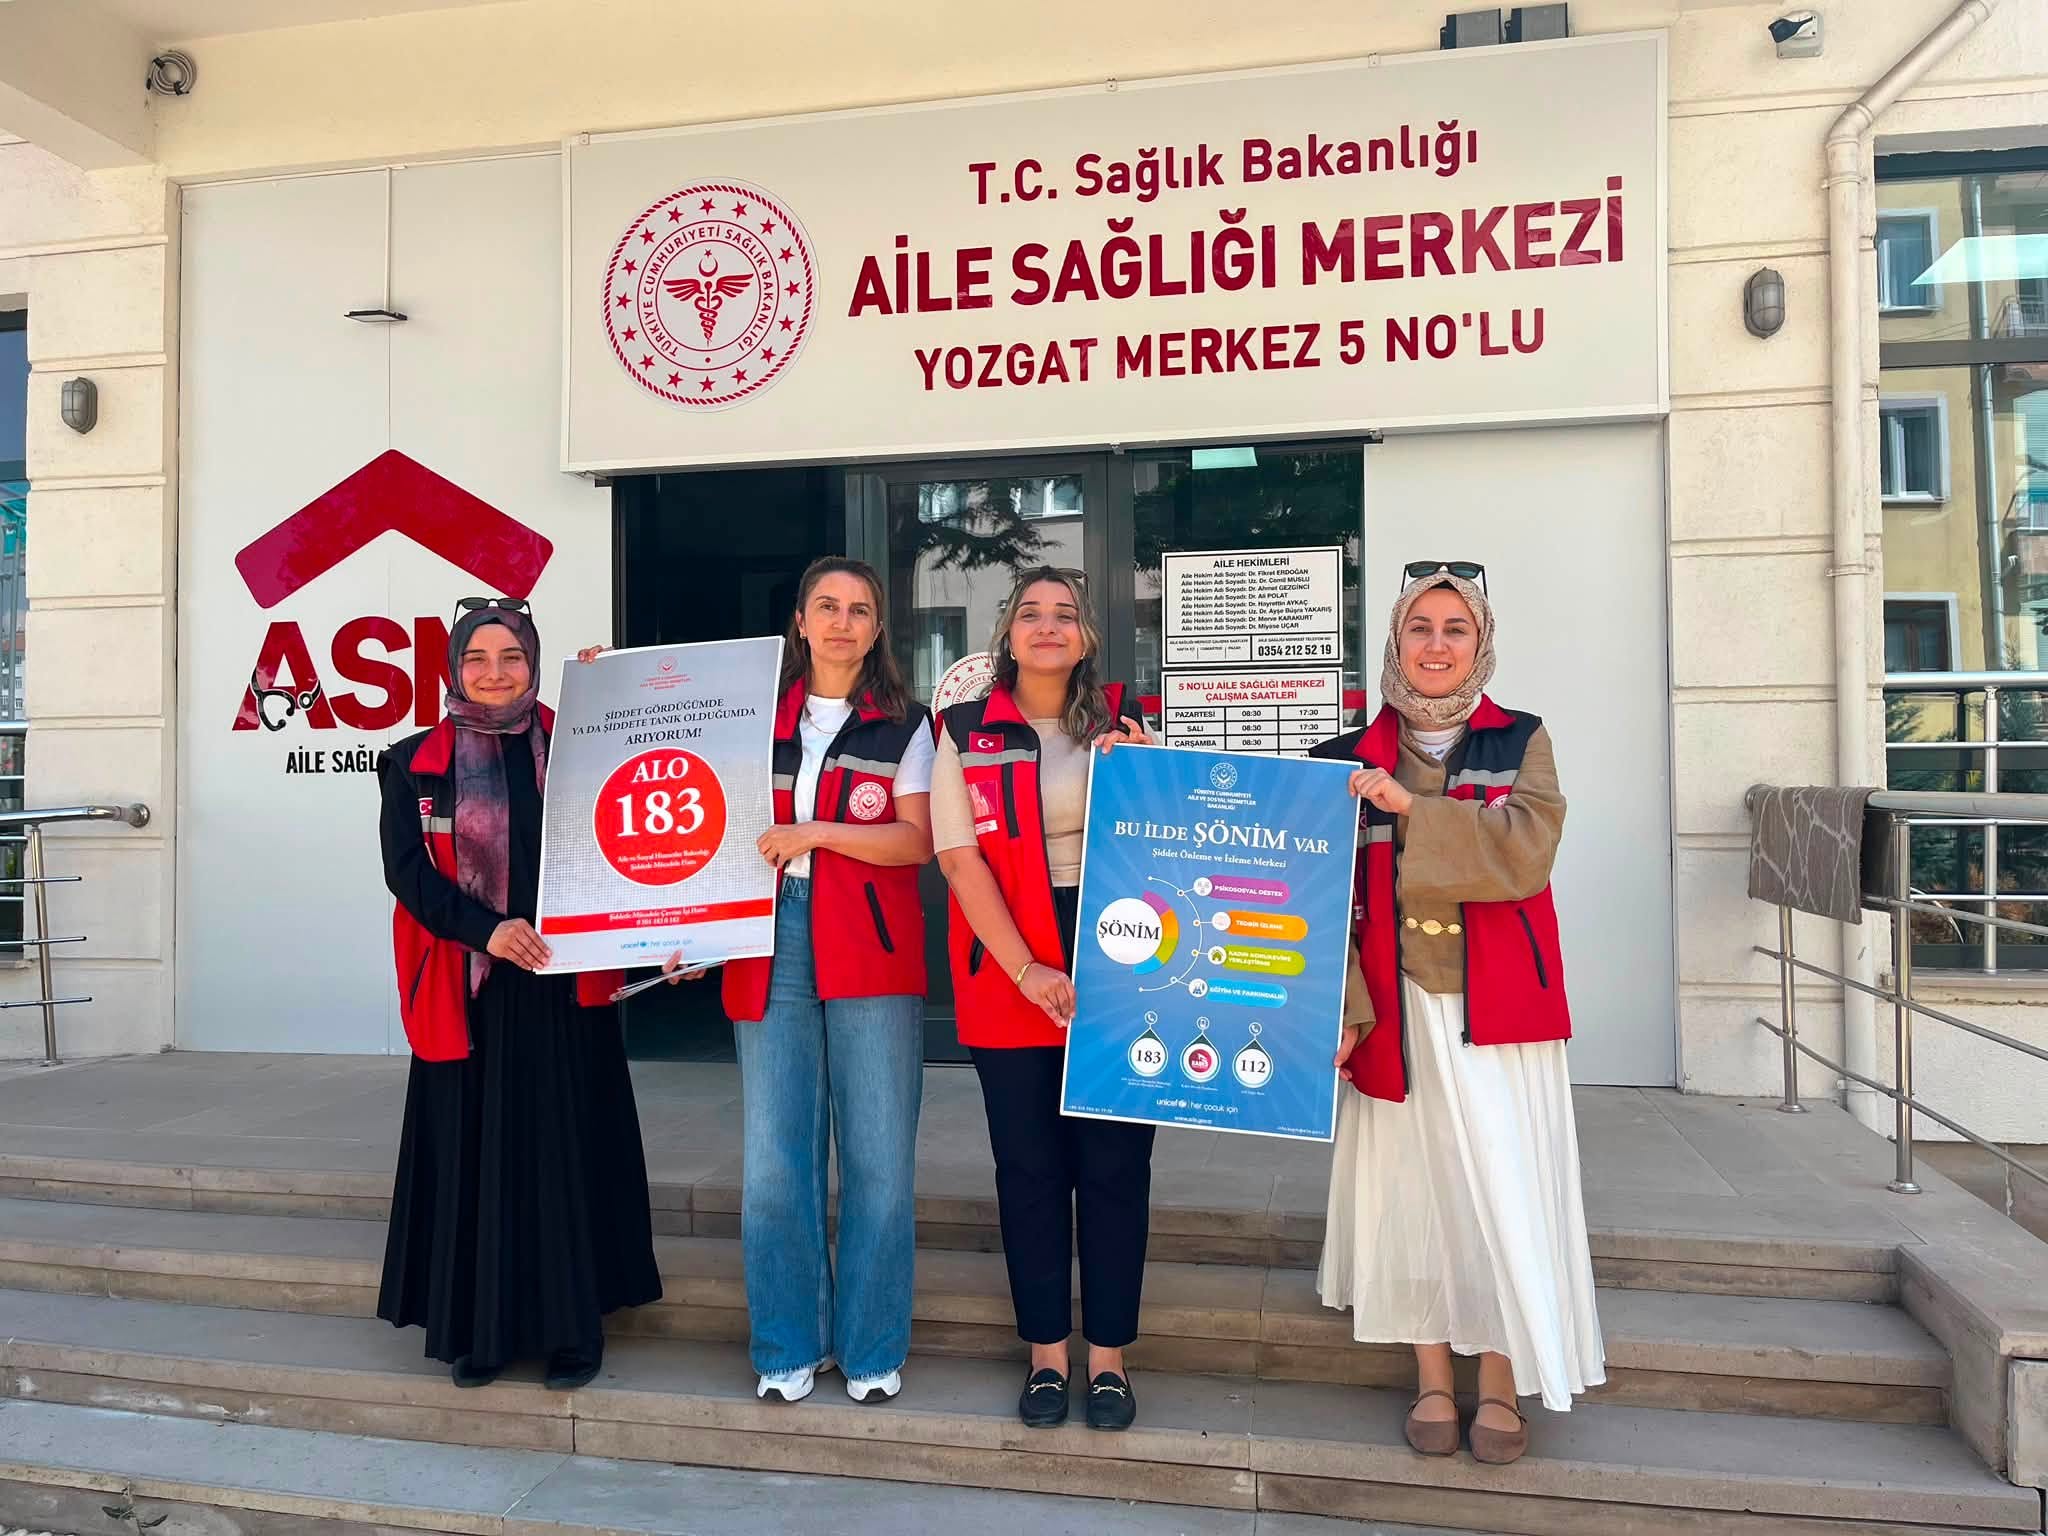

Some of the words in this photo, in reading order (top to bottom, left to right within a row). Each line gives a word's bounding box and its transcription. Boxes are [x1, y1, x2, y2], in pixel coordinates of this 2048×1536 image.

[970, 159, 1058, 205] T.C.
[1075, 144, 1224, 205] Sağlık
[1244, 120, 1479, 184] Bakanlığı
[725, 229, 766, 268] SAĞLIK
[848, 234, 994, 318] AİLE
[1011, 216, 1277, 308] SAĞLIĞI
[1301, 176, 1624, 287] MERKEZİ
[643, 224, 721, 295] CUMHURİYETİ
[738, 270, 774, 352] BAKANLIĞI
[643, 301, 679, 357] TÜRKİYE
[914, 337, 1099, 391] YOZGAT
[1116, 323, 1321, 380] MERKEZ
[1340, 319, 1366, 366] 5
[1386, 308, 1545, 363] NO'LU
[1213, 558, 1235, 568] AİLE
[1236, 556, 1290, 567] HEKİMLERİ
[1304, 605, 1332, 613] YAKARIŞ
[1258, 645, 1283, 656] 0354
[1285, 644, 1303, 656] 212
[1304, 644, 1317, 655] 52
[1320, 644, 1332, 654] 19
[1178, 683, 1184, 691] 5
[1186, 681, 1214, 690] NO'LU
[1217, 680, 1237, 690] AİLE
[1239, 679, 1278, 689] SAĞLIĞI
[1282, 678, 1325, 688] MERKEZİ
[1206, 692, 1249, 702] ÇALIŞMA
[1251, 690, 1297, 700] SAATLERİ
[573, 727, 584, 736] YA
[586, 725, 601, 734] DA
[603, 718, 646, 733] ŞİDDETE
[650, 714, 682, 726] TANIK
[684, 708, 756, 722] OLDUĞUMDA
[605, 708, 642, 722] ŞİDDET
[644, 698, 724, 715] GÖRDÜĞÜMDE
[624, 728, 702, 746] ARIYORUM!
[1175, 740, 1216, 748] ÇARŞAMBA
[286, 745, 326, 774] AİLE
[632, 757, 689, 783] ALO
[617, 788, 705, 837] 183
[1115, 820, 1140, 836] BU
[1144, 820, 1188, 841] İLDE
[1192, 819, 1288, 850] ŞÖNİM
[1293, 837, 1329, 854] VAR
[1152, 848, 1178, 858] Şiddet
[1180, 849, 1212, 861] Önleme
[1224, 853, 1251, 865] İzleme
[1253, 857, 1287, 868] Merkezi
[1215, 885, 1257, 895] PSİKOSOSYAL
[1098, 916, 1160, 941] ŞÖNİM
[1136, 1049, 1161, 1064] 183
[1241, 1059, 1266, 1073] 112
[1156, 1099, 1178, 1107] unicef
[1191, 1099, 1202, 1109] her
[1204, 1104, 1224, 1113] çocuk
[1226, 1106, 1238, 1115] için
